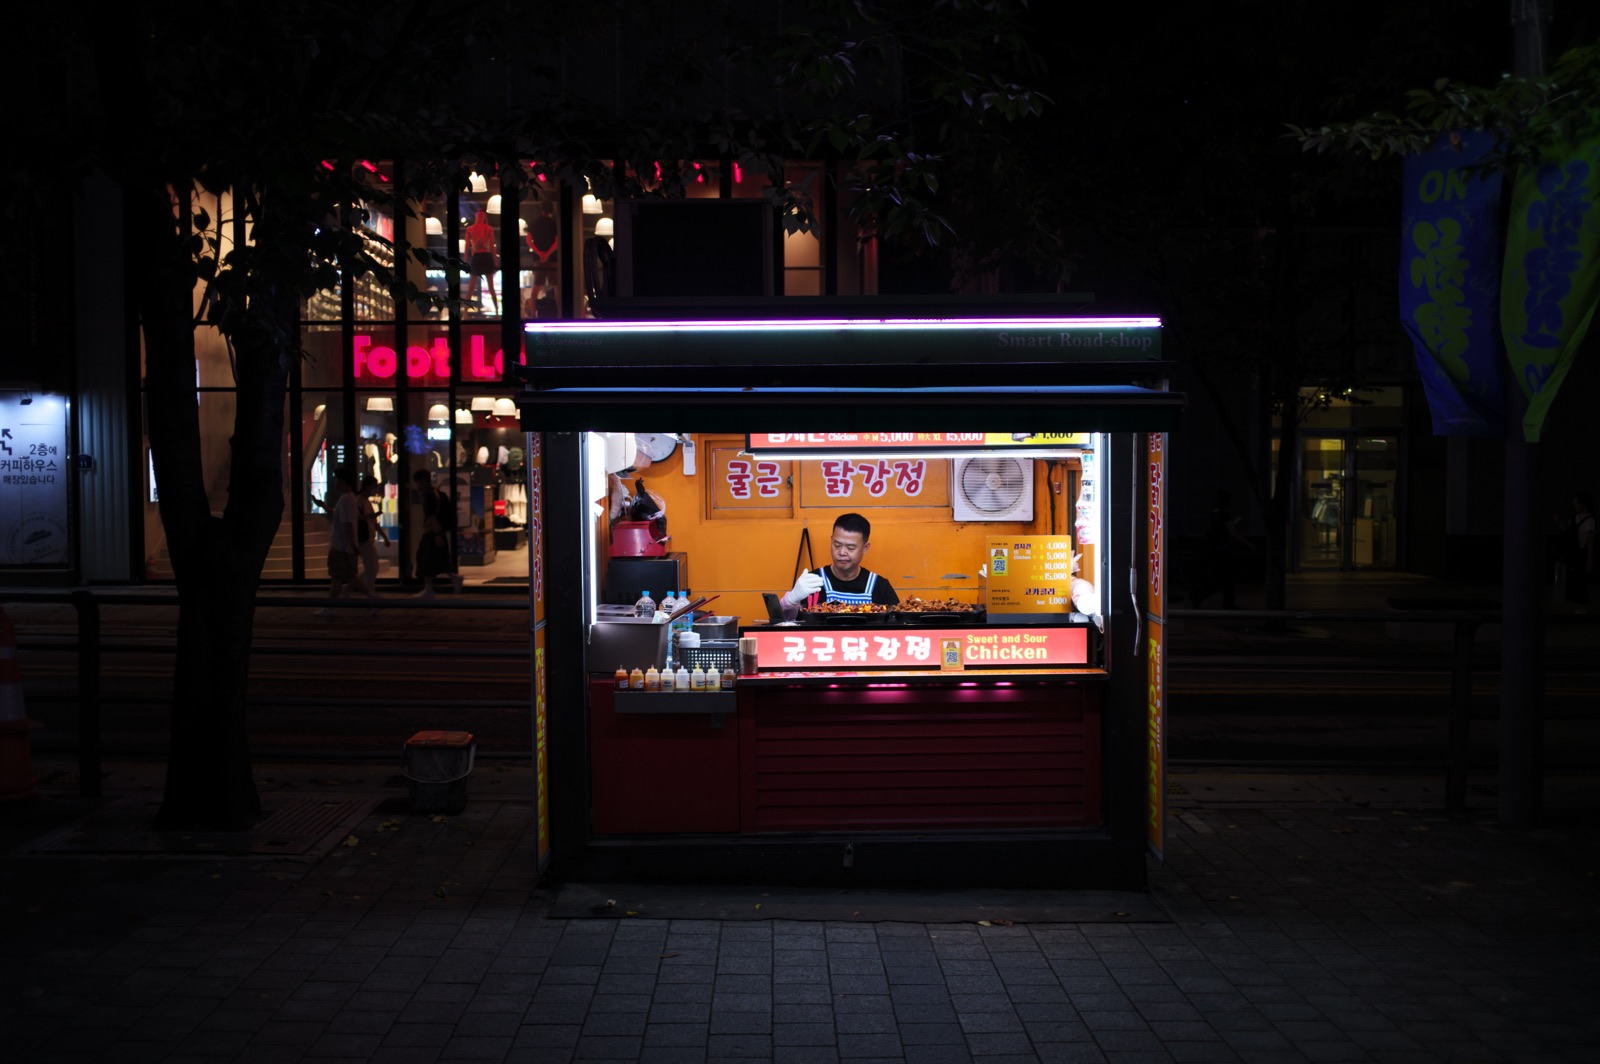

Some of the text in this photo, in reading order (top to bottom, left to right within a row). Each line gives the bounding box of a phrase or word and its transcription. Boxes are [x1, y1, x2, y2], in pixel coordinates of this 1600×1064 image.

[998, 331, 1153, 352] Smart Road-shop
[352, 335, 450, 378] Foot
[828, 433, 858, 442] Chicken
[880, 432, 914, 443] 5,000
[945, 432, 983, 443] 15,000
[29, 443, 57, 457] 2층에
[0, 459, 57, 472] 커피하우스
[3, 475, 58, 485] 매장있습니다.
[727, 459, 926, 499] 굴근 닭강정
[1150, 462, 1162, 596] 닭강정
[967, 633, 1047, 644] Sweet and Sour
[965, 644, 1047, 660] Chicken
[1148, 637, 1158, 830] K-CHICKEN
